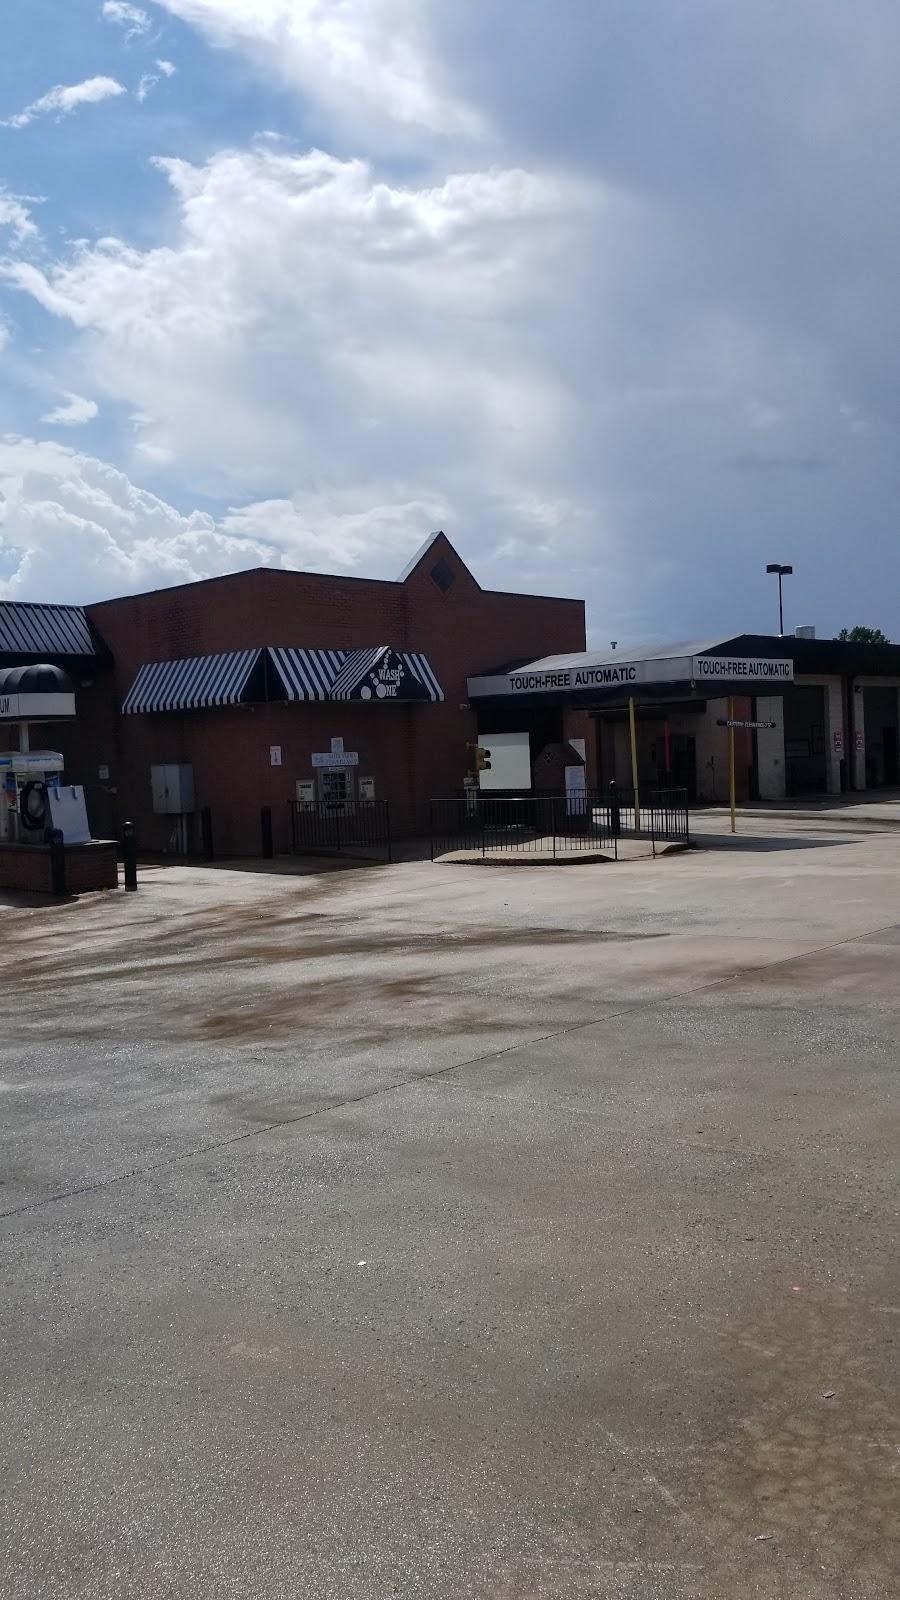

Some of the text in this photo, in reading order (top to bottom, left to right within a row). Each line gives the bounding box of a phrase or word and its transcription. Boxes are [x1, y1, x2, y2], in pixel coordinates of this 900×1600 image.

[378, 669, 401, 681] WASH
[698, 661, 790, 676] TOUCH-FREE AUTOMATIC
[509, 667, 636, 690] TOUCH-FREE AUTOMATIC
